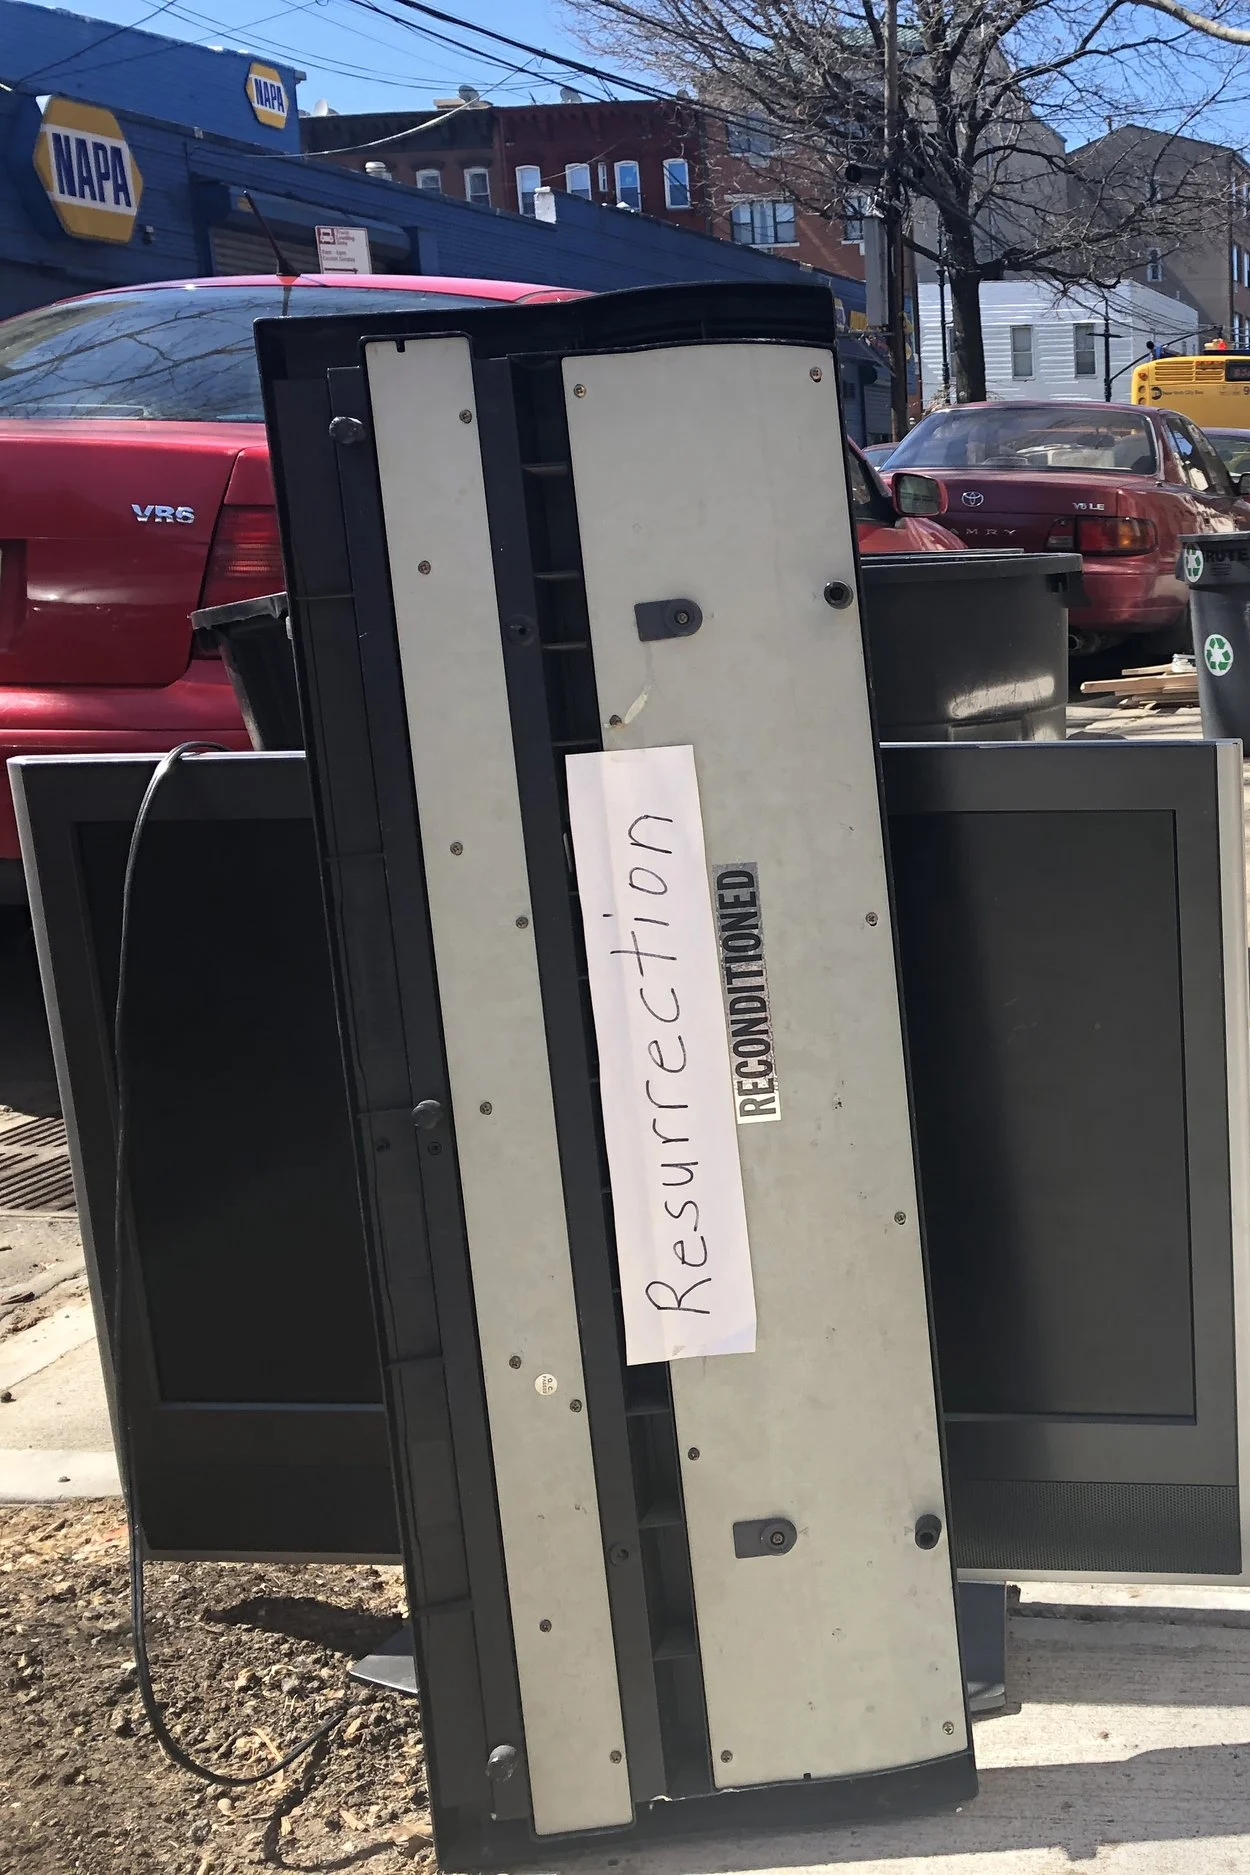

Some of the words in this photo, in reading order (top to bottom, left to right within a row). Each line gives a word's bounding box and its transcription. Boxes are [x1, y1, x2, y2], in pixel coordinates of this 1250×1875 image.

[253, 77, 286, 114] NAPA
[52, 132, 132, 208] NAPA
[131, 503, 195, 524] VR6
[950, 527, 1016, 536] AMRY
[1205, 549, 1249, 563] RUTE
[716, 869, 777, 1118] RECONDITIONED
[602, 813, 712, 1314] Resurrection
